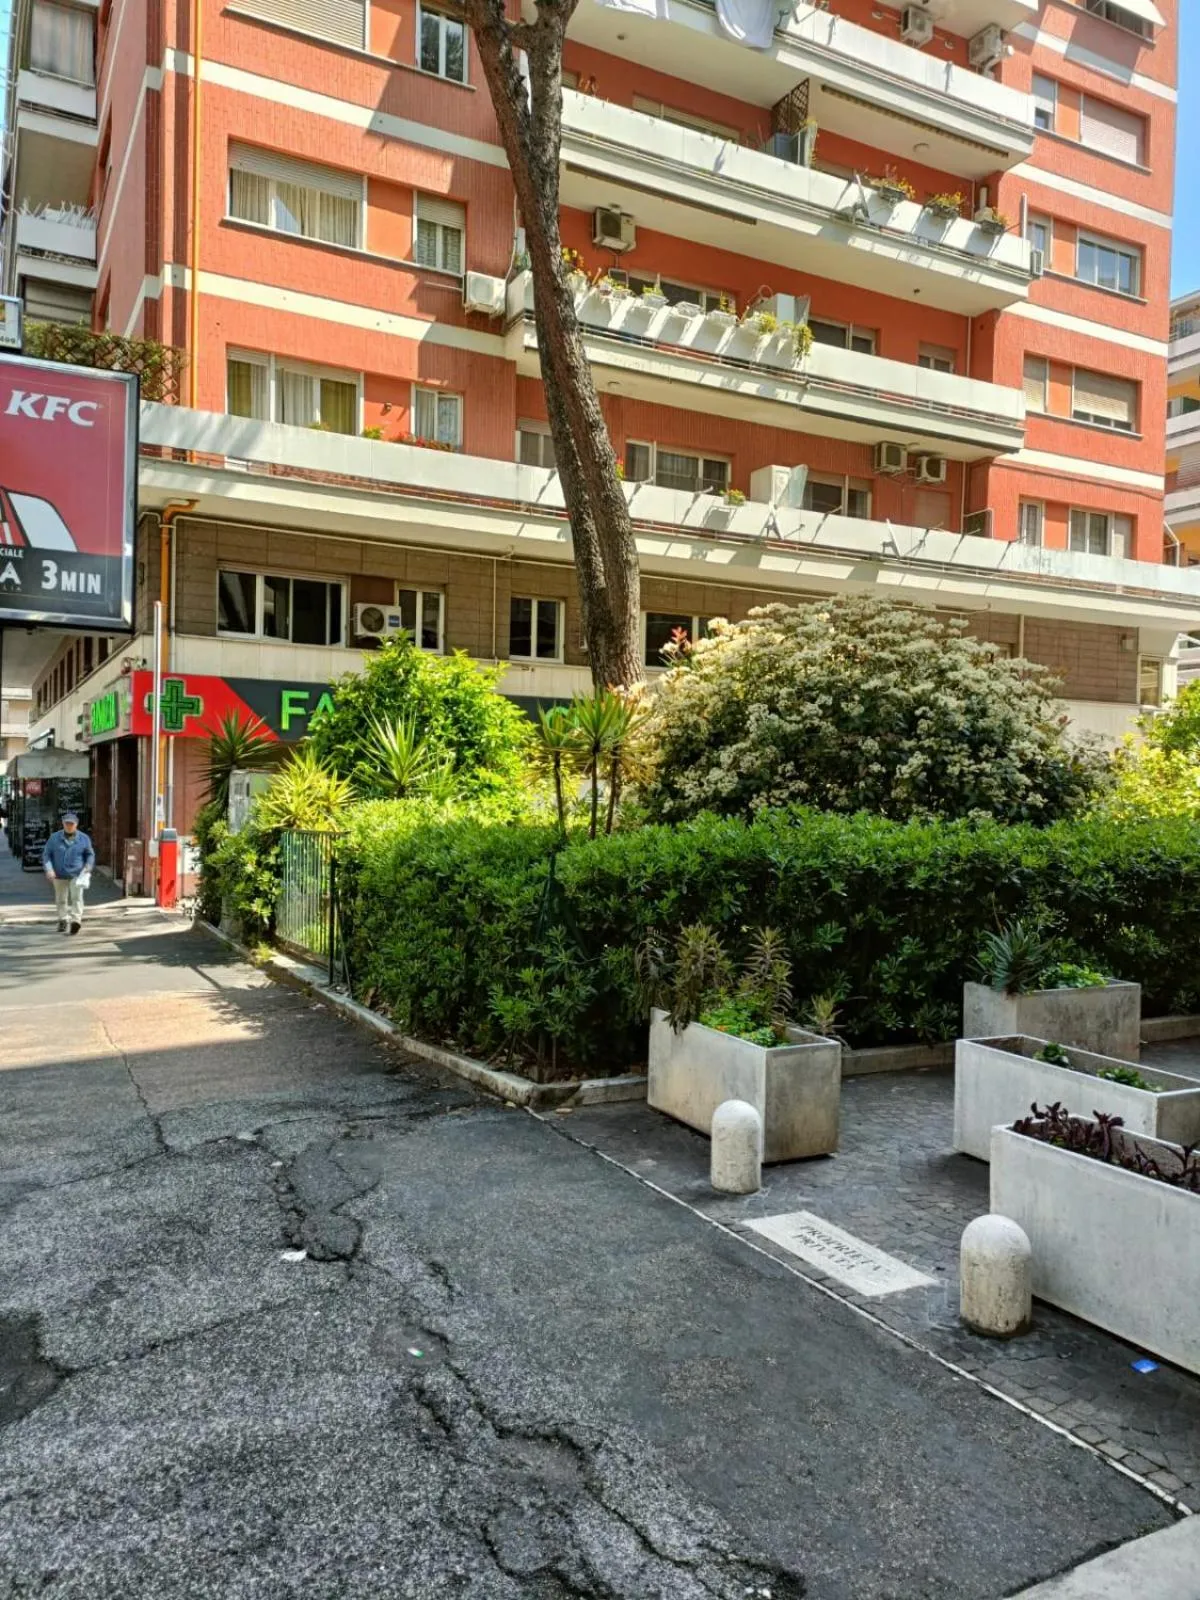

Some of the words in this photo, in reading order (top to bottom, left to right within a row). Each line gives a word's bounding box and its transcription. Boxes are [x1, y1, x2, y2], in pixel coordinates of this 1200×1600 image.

[4, 389, 98, 427] KFC
[0, 561, 21, 586] A
[791, 1233, 856, 1271] PRIVATA
